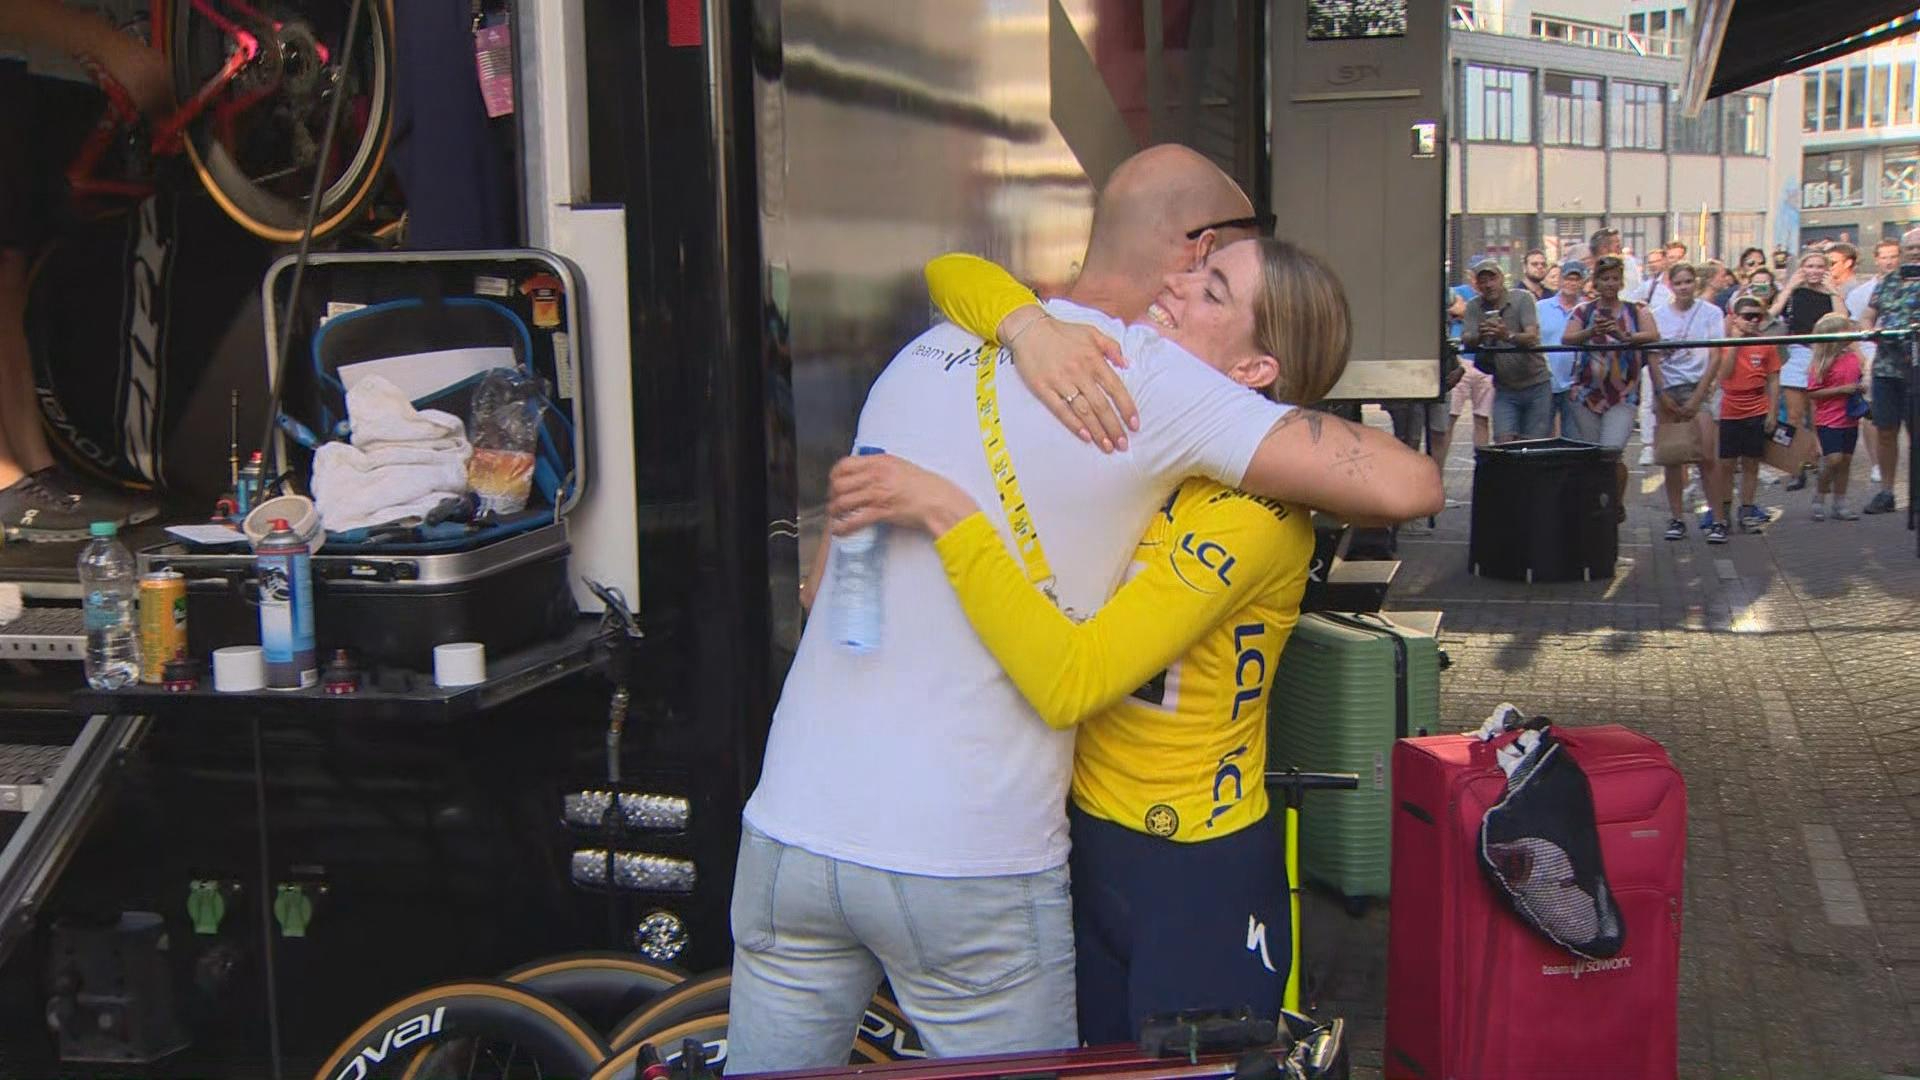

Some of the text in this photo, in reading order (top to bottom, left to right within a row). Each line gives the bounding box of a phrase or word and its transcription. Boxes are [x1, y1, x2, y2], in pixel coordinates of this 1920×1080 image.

[1181, 532, 1236, 587] LCL
[1234, 622, 1265, 722] LCL
[333, 1006, 447, 1080] oval
